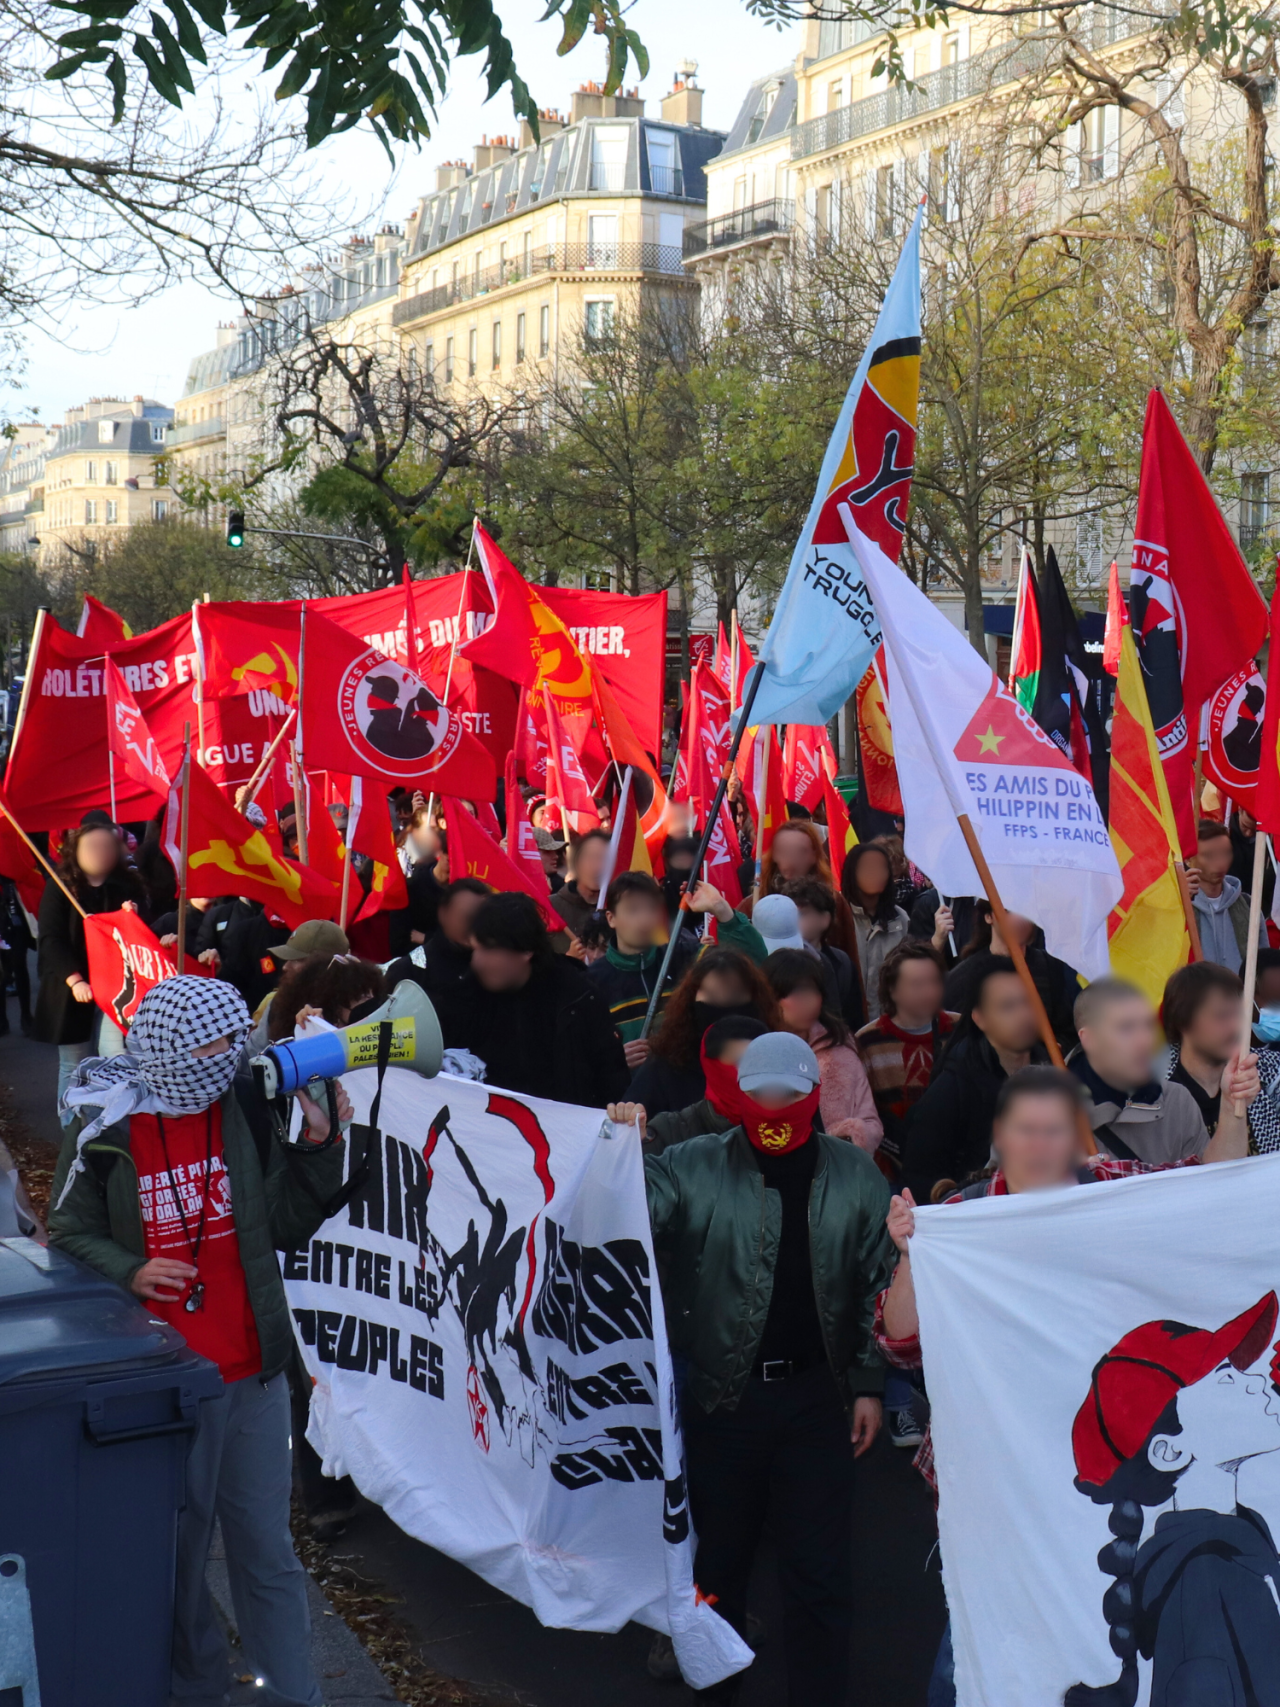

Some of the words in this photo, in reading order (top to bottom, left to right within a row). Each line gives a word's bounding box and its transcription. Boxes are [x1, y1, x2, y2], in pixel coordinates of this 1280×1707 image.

[429, 616, 459, 647] DU
[569, 625, 631, 658] TIER,
[343, 667, 364, 731] JEUNES
[1213, 669, 1247, 730] JEUNES
[994, 774, 1049, 797] AMIS
[1055, 777, 1081, 798] DU
[1067, 801, 1092, 822] EN
[1004, 823, 1038, 839] FFPS
[1054, 826, 1110, 848] FRANCE
[360, 1045, 371, 1053] DU
[284, 1240, 391, 1300] ENTRE
[399, 1260, 439, 1316] LES
